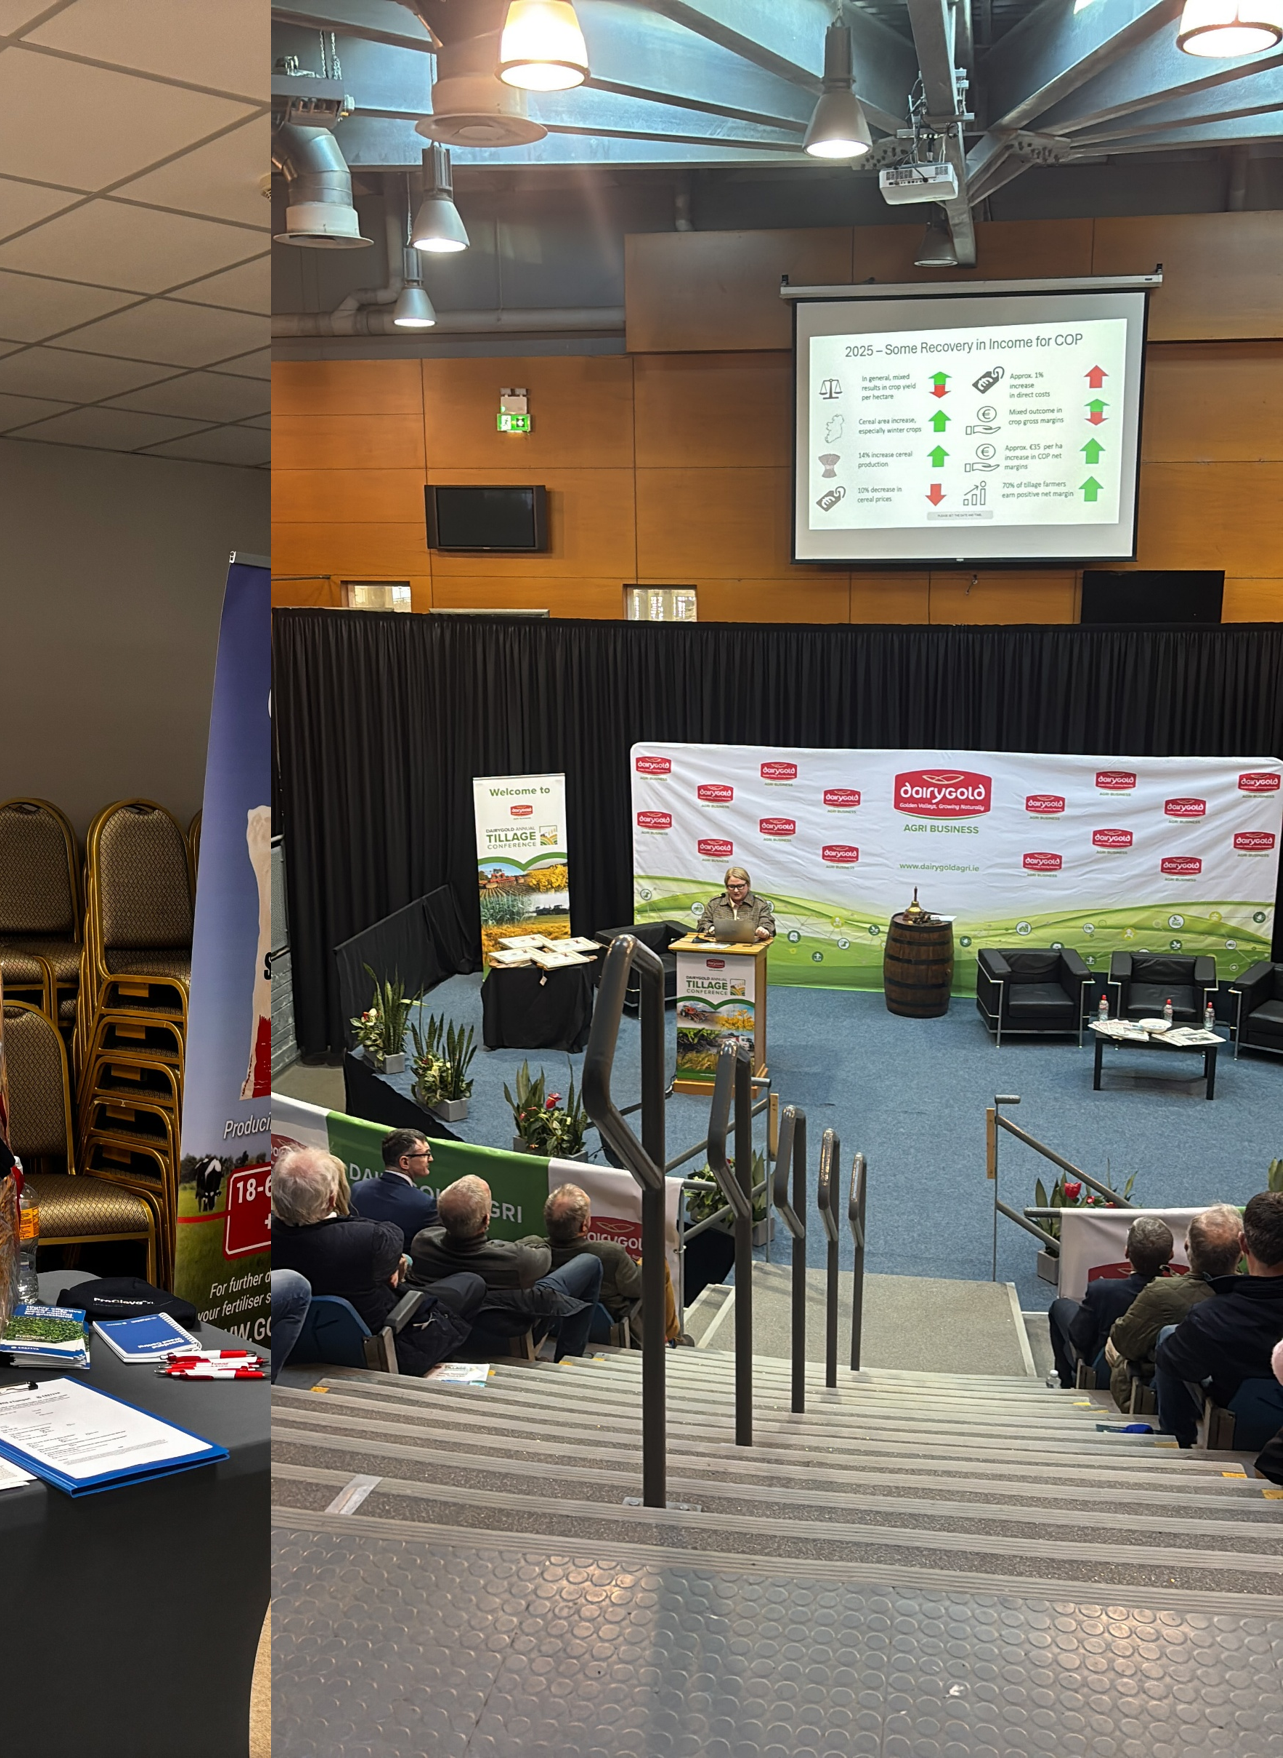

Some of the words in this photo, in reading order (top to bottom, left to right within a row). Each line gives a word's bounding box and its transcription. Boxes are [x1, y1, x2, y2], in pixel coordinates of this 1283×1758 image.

[845, 345, 874, 358] 2025
[885, 343, 918, 356] Some
[920, 341, 973, 354] Recovery
[976, 338, 986, 350] in
[989, 337, 1033, 350] Income
[1035, 335, 1052, 347] for
[1054, 333, 1083, 346] COP
[1009, 372, 1034, 380] Approx.
[861, 384, 880, 392] results
[1009, 408, 1027, 416] Mixed
[1029, 407, 1055, 415] outcome
[1008, 418, 1022, 426] crop
[1023, 418, 1039, 426] gross
[1040, 416, 1064, 425] margins
[858, 427, 886, 435] especially
[886, 426, 905, 434] winter
[906, 425, 922, 433] crops
[1004, 453, 1029, 461] increase
[858, 461, 889, 469] production
[1004, 463, 1028, 471] margins
[1043, 480, 1066, 488] farmers
[1017, 490, 1040, 499] positive
[1054, 490, 1074, 499] margin
[875, 496, 892, 504] prices
[489, 786, 537, 797] Welcome
[540, 786, 551, 795] to
[900, 782, 985, 803] dairygold
[903, 824, 927, 833] AGRI
[930, 825, 979, 834] BUSINESS
[486, 831, 536, 844] TILLAGE
[487, 841, 537, 850] CONFERENCE
[899, 863, 980, 872] www.dairygoldagri.ie
[686, 980, 728, 990] TILLAGE
[686, 988, 728, 996] CONFERENCE
[209, 1282, 227, 1298] For
[229, 1272, 263, 1293] further
[222, 1294, 264, 1317] fertiliser
